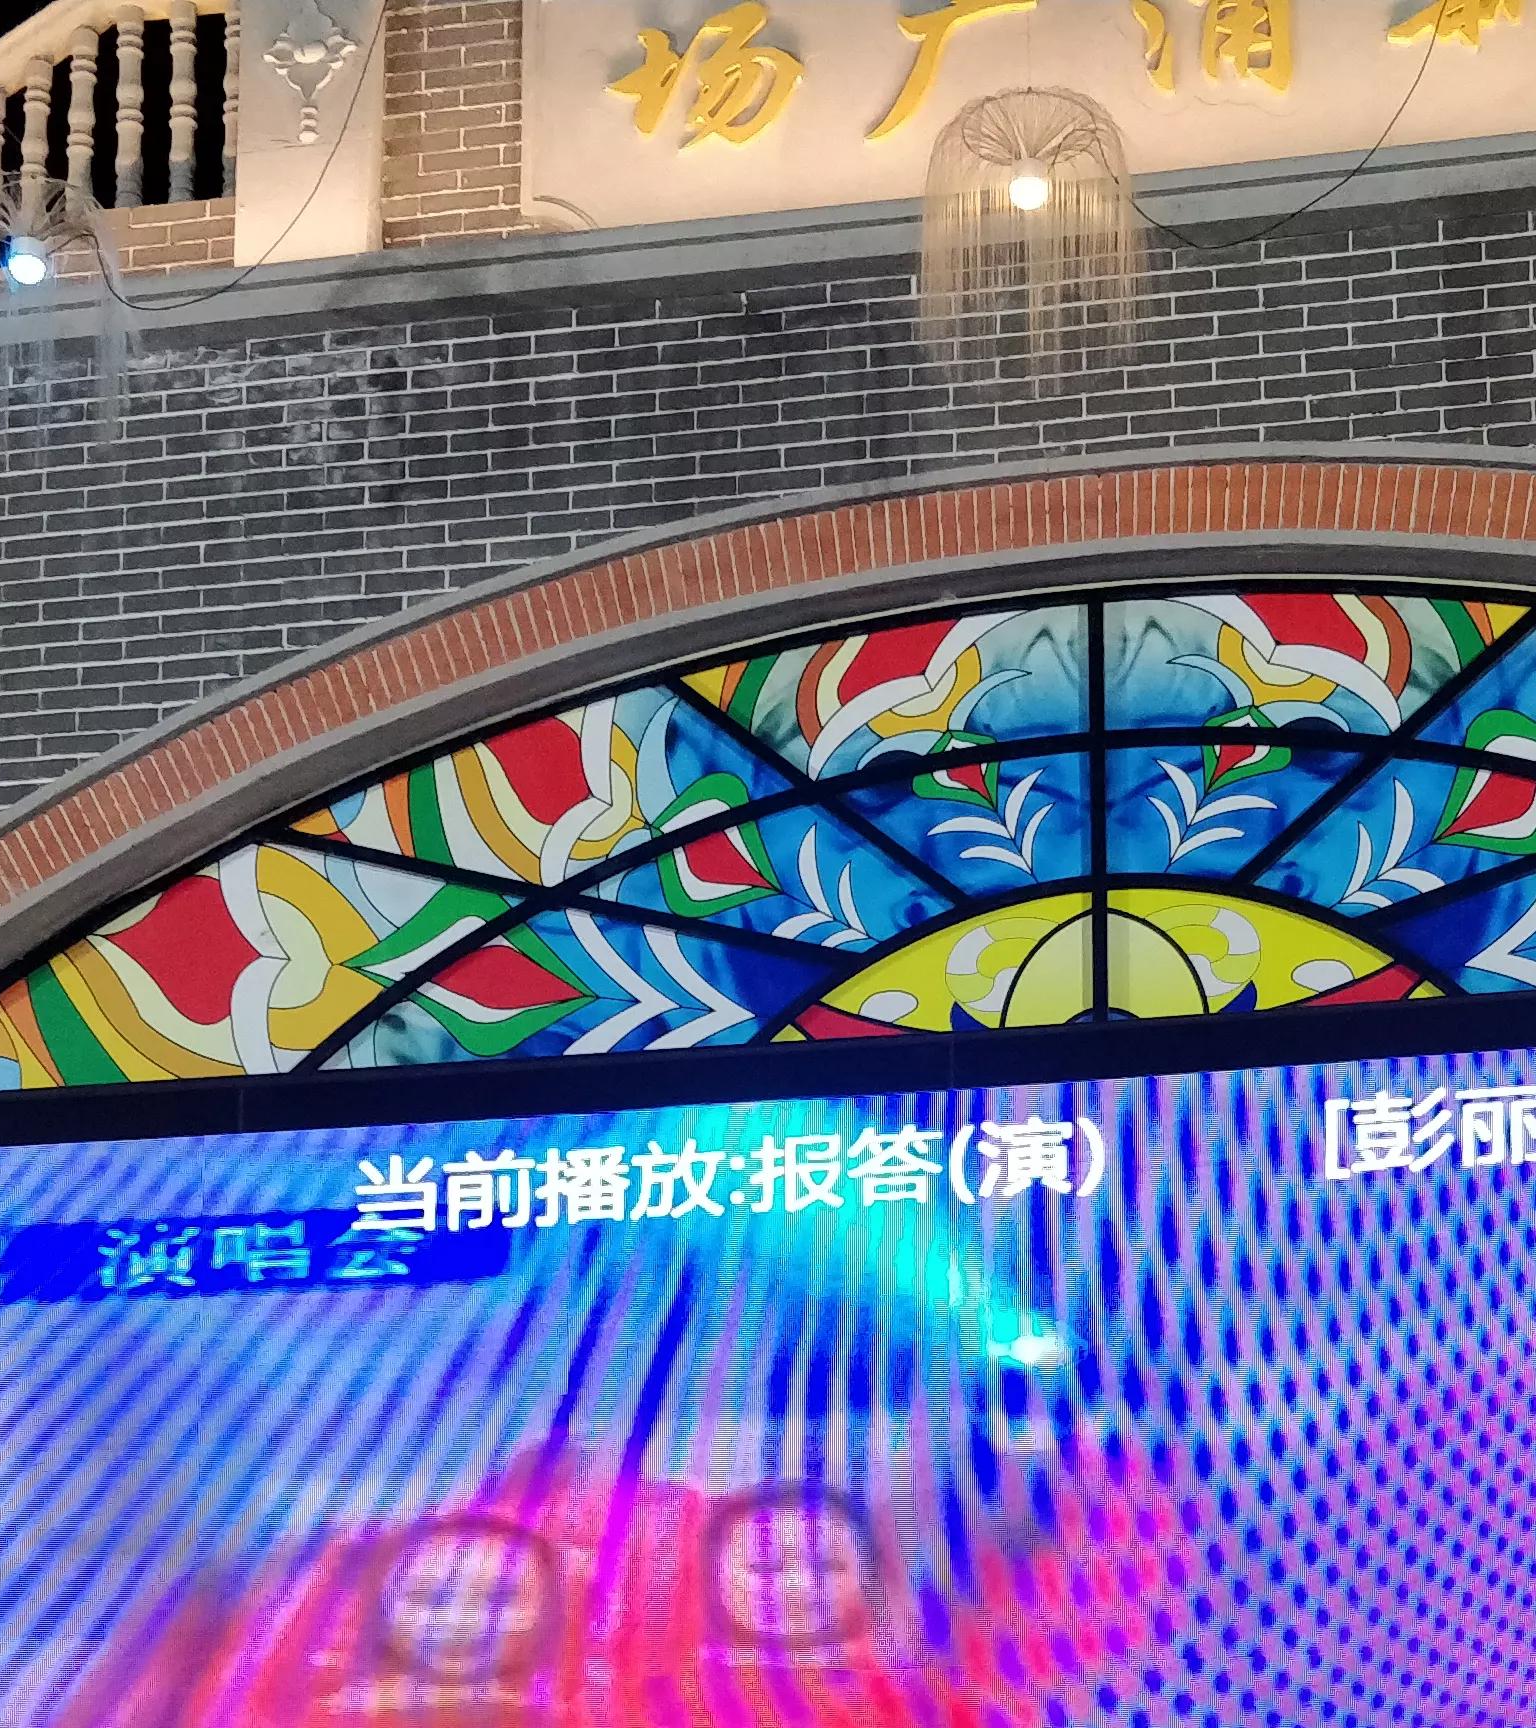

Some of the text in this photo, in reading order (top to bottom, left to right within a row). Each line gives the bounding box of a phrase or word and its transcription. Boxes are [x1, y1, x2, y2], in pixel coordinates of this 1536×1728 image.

[352, 1117, 1108, 1238] 当前播放:报答(演)
